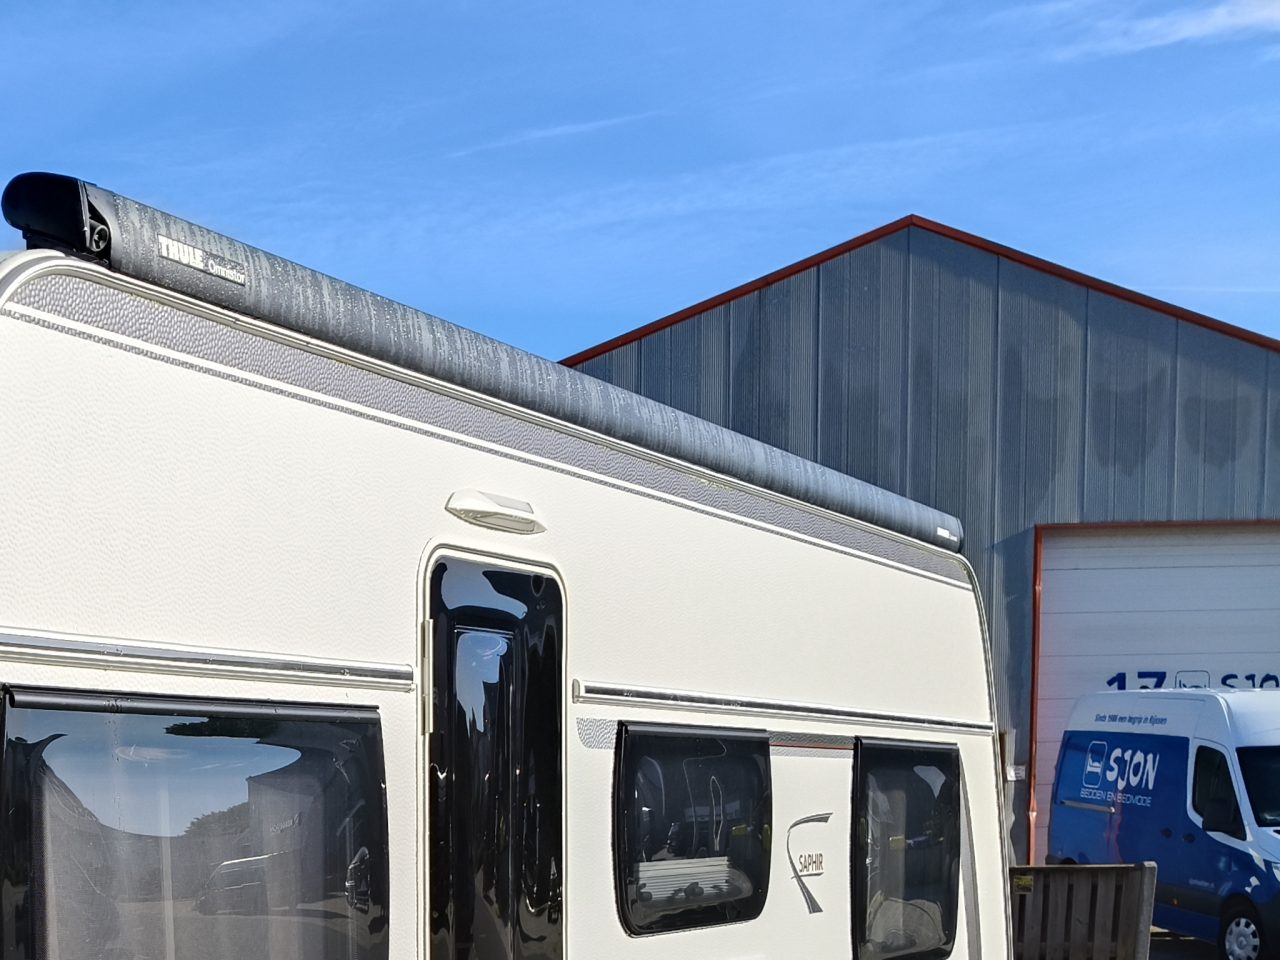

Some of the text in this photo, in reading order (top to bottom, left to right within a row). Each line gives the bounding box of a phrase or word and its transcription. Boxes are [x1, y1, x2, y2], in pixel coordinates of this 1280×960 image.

[160, 234, 204, 270] THULE
[1105, 748, 1160, 791] SJON
[798, 852, 824, 873] SAPHIR
